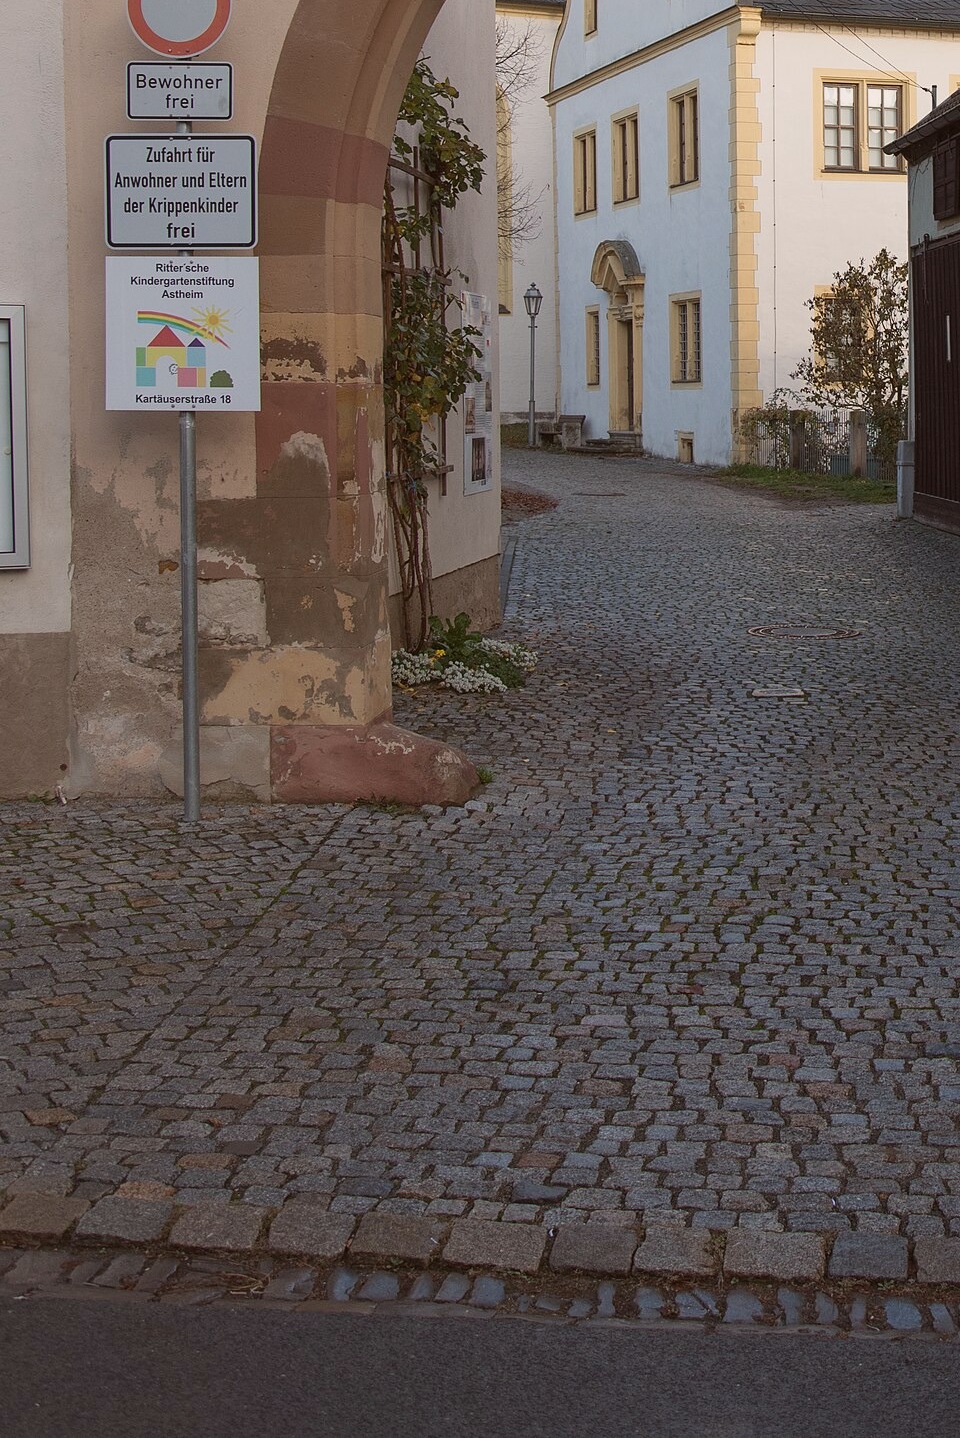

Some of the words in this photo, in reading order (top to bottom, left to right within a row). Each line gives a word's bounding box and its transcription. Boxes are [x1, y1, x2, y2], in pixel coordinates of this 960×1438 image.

[136, 73, 223, 90] Bewohner
[165, 94, 195, 109] frei
[146, 146, 193, 163] Zufahrt
[196, 146, 216, 163] für
[114, 172, 178, 188] Anwohner
[181, 172, 205, 188] und
[208, 172, 247, 188] Eltern
[123, 197, 144, 213] der
[149, 197, 239, 217] Krippenkinder
[166, 222, 195, 238] frei
[130, 275, 235, 288] Kindergartenstiftung
[161, 289, 204, 299] Astheim
[135, 394, 217, 404] Kartäuserstraße
[220, 394, 231, 404] 18
